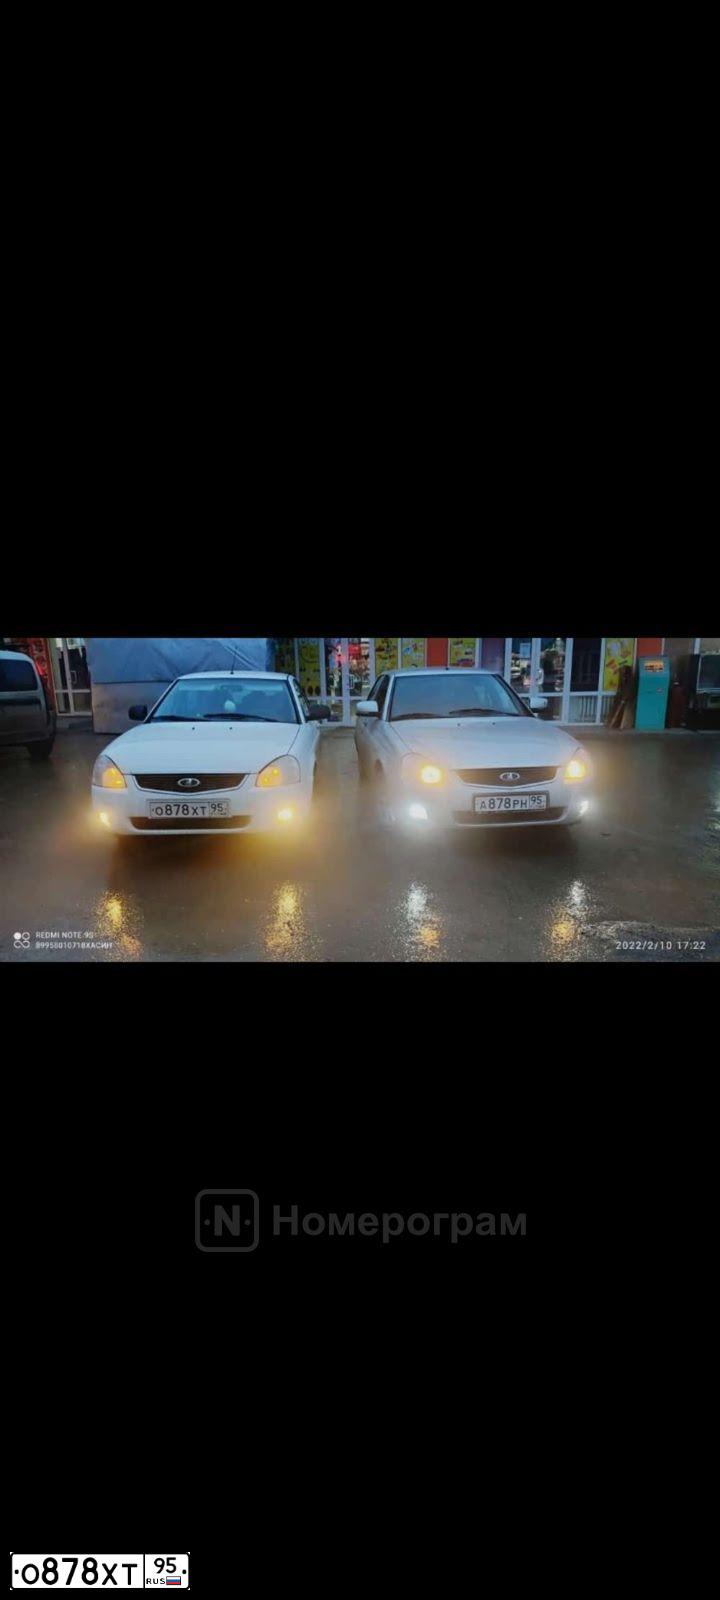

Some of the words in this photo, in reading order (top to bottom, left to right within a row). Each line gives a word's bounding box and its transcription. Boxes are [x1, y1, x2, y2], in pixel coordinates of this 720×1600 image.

[155, 804, 207, 816] О878ХТ
[210, 803, 224, 813] 95
[480, 797, 528, 810] А878РН
[530, 795, 543, 805] 95
